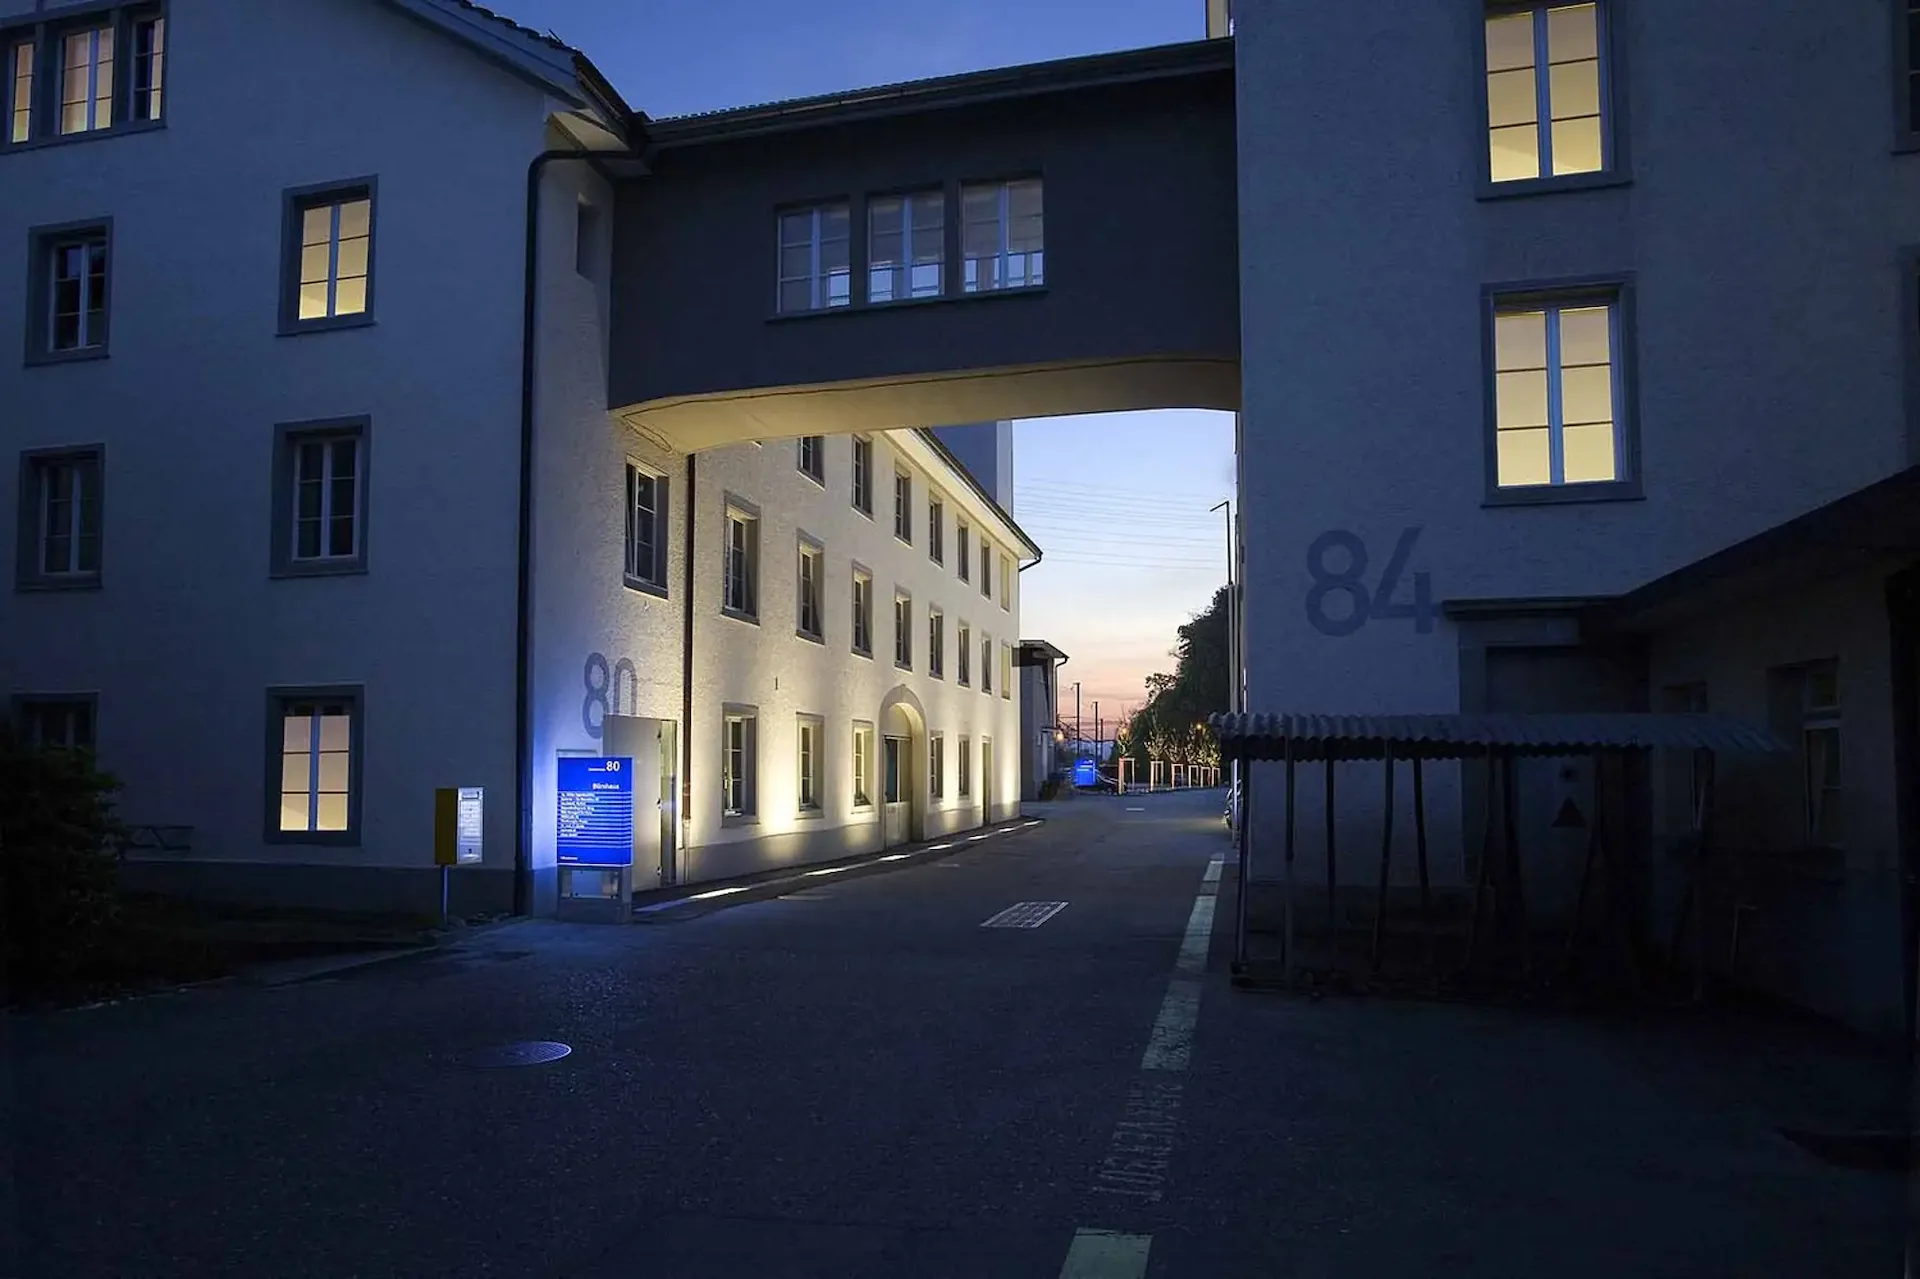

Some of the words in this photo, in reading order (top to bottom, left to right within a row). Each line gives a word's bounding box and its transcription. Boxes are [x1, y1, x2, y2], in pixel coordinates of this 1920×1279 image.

[1306, 526, 1439, 636] 84
[584, 652, 637, 738] 80
[606, 761, 620, 771] 80
